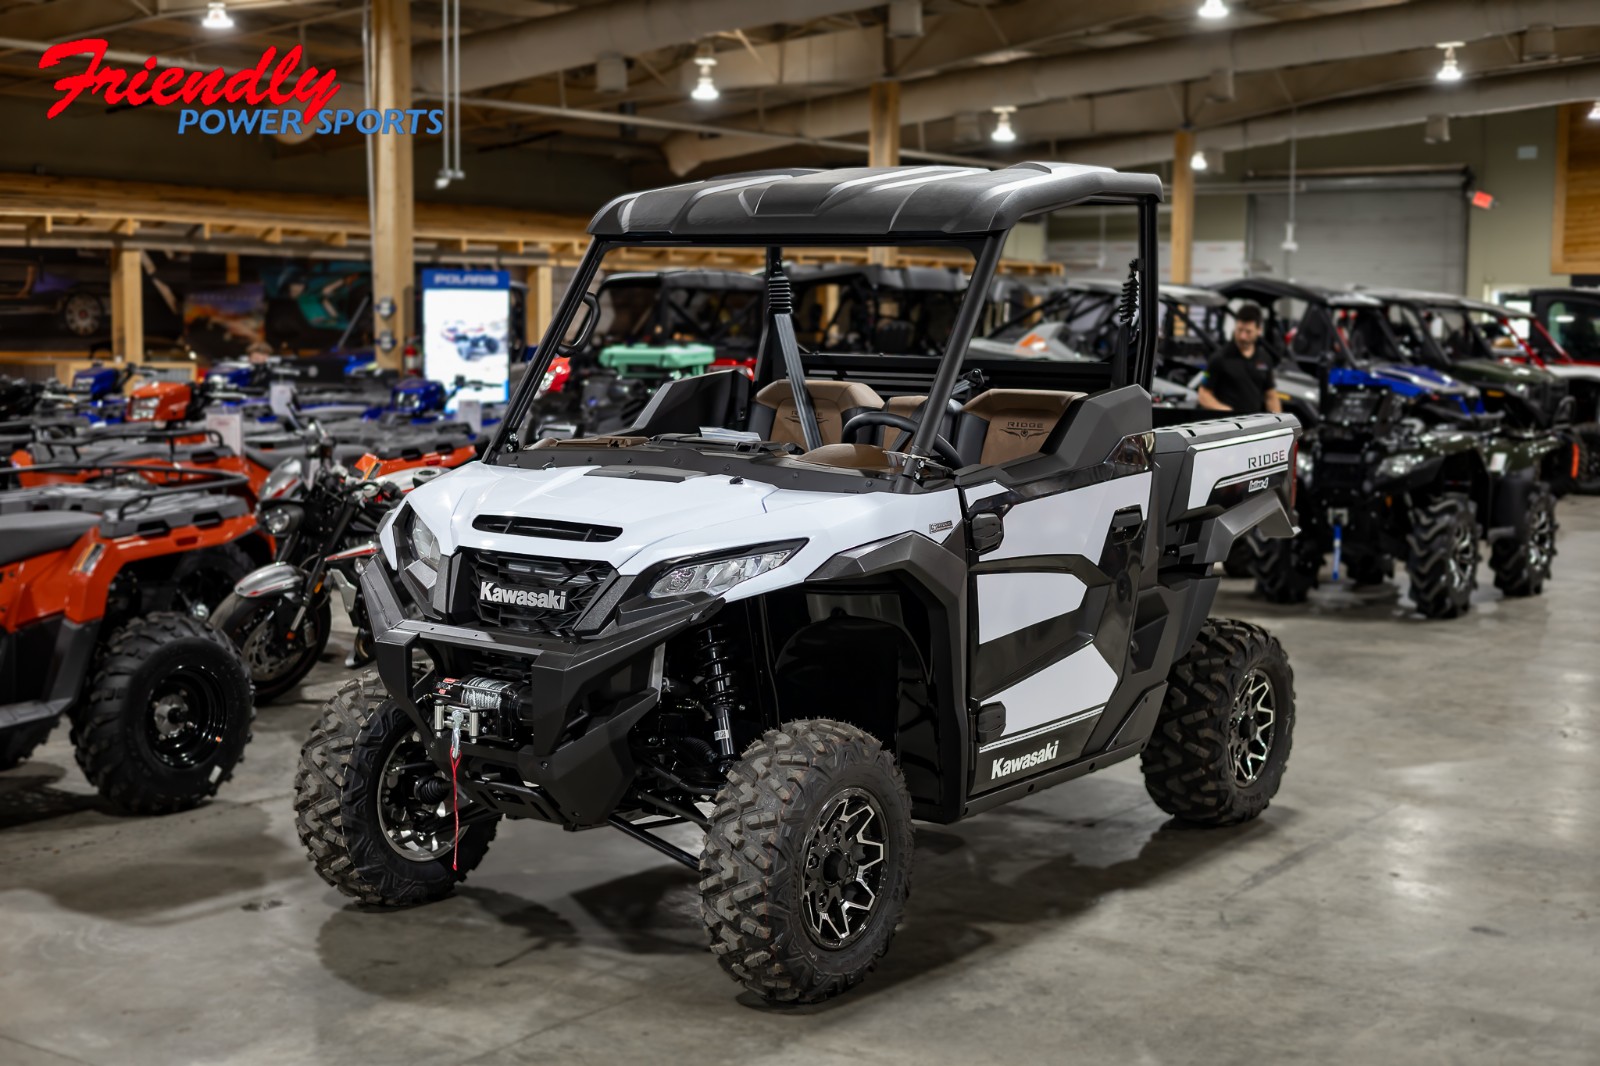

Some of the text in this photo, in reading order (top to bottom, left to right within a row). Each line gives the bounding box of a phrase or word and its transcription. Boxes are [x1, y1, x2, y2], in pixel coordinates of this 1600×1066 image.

[434, 274, 498, 286] POLARIS
[1007, 421, 1044, 429] RIDGE
[1248, 450, 1285, 469] RIDGE
[480, 581, 566, 610] Kawasaki
[991, 740, 1060, 780] Kawasaki
